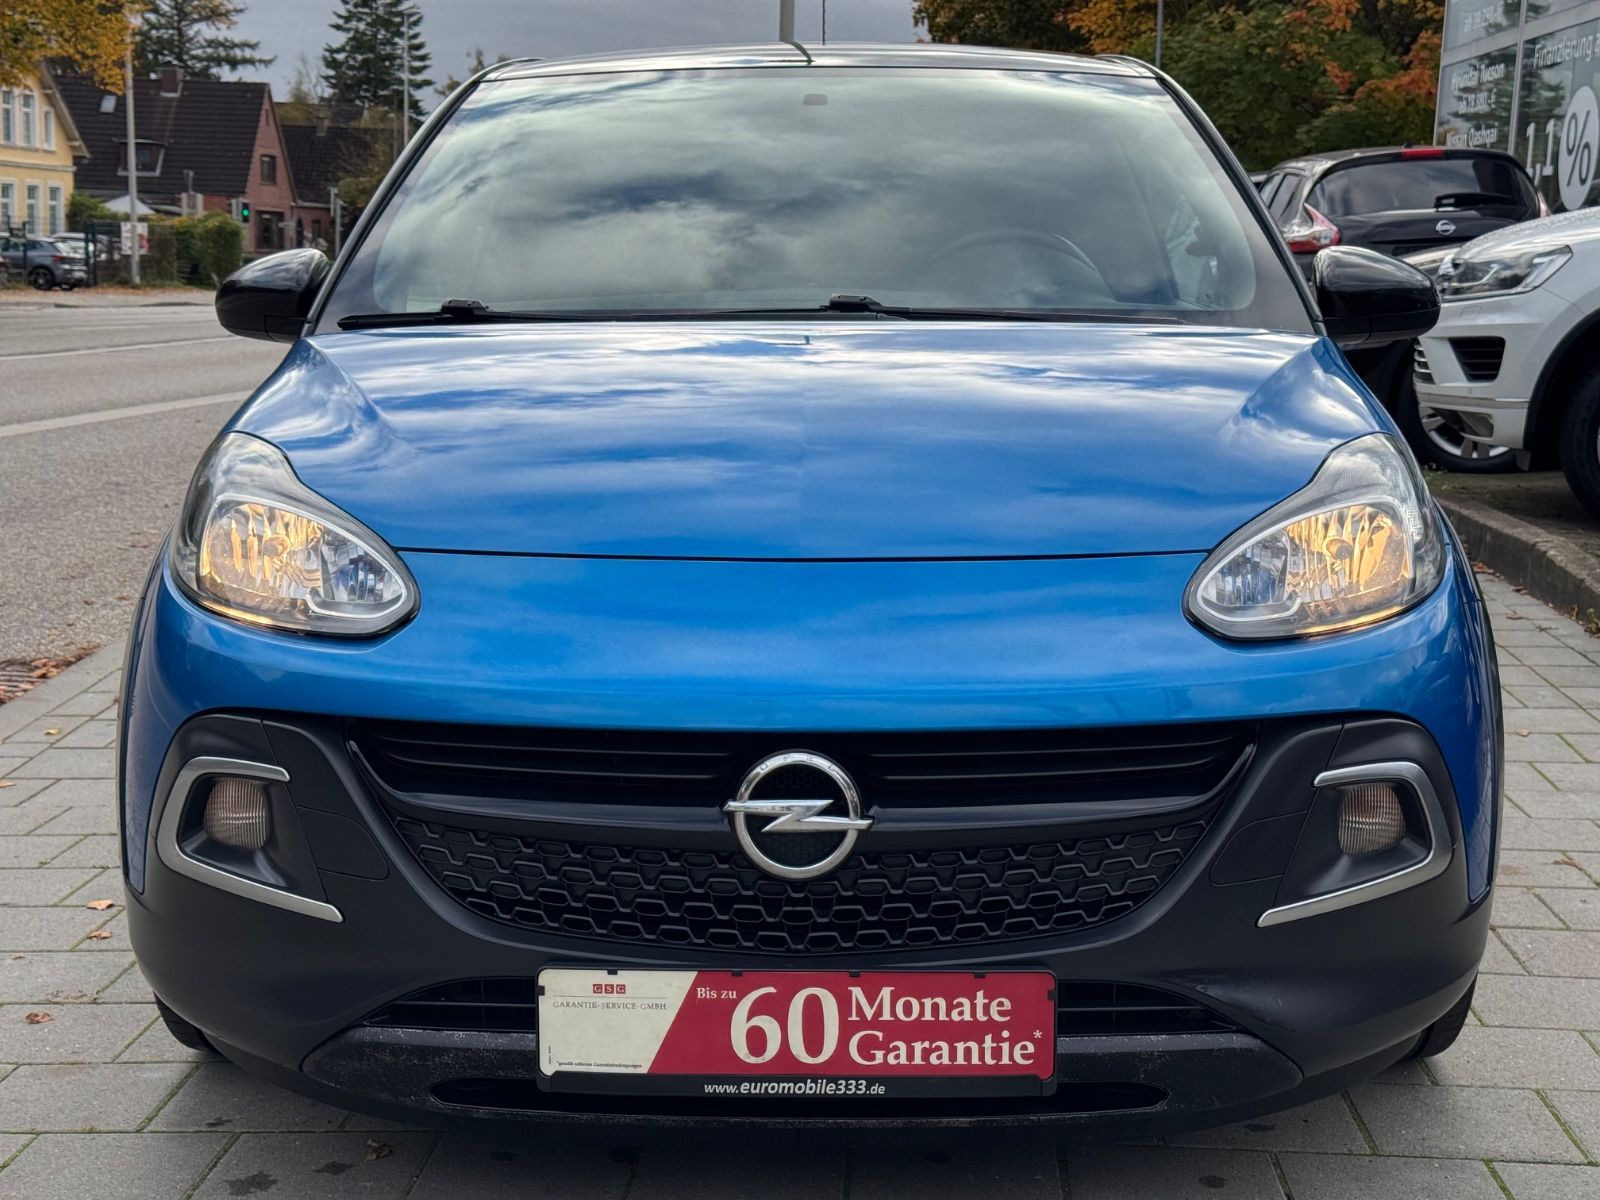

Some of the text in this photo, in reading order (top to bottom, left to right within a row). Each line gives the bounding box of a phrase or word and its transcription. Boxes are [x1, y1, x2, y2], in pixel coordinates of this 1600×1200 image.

[1533, 34, 1594, 69] Finanzierung
[1469, 122, 1498, 149] Qashqai
[593, 984, 626, 994] GSG
[696, 987, 737, 999] Bis zu
[552, 1001, 667, 1010] GARANTIE-SERVICE-GMBH
[848, 986, 1012, 1022] Monate
[730, 986, 840, 1064] 60
[704, 1079, 886, 1095] www.euromobile333.de
